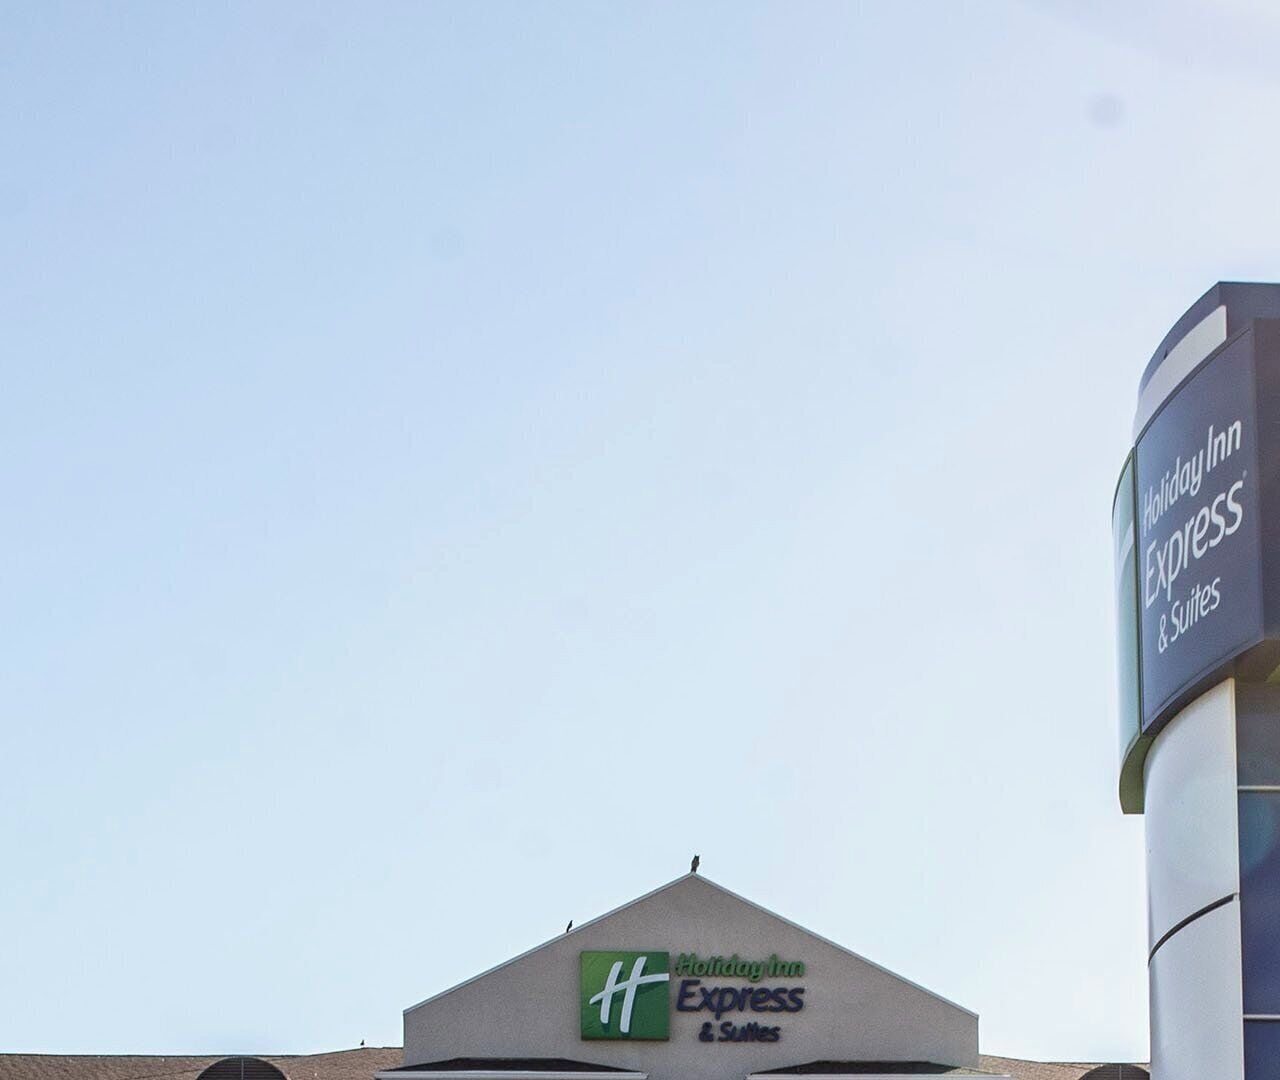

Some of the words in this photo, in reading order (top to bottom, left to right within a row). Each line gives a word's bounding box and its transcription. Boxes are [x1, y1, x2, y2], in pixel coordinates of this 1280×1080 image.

[1143, 449, 1204, 537] Holiday
[1206, 420, 1242, 473] Inn
[1145, 480, 1244, 609] Express
[1158, 614, 1169, 654] &
[1170, 577, 1221, 643] Suites
[675, 953, 765, 982] Holiday
[769, 953, 806, 977] Inn
[676, 979, 806, 1021] Express
[698, 1021, 714, 1042] &
[718, 1021, 782, 1042] Suites
